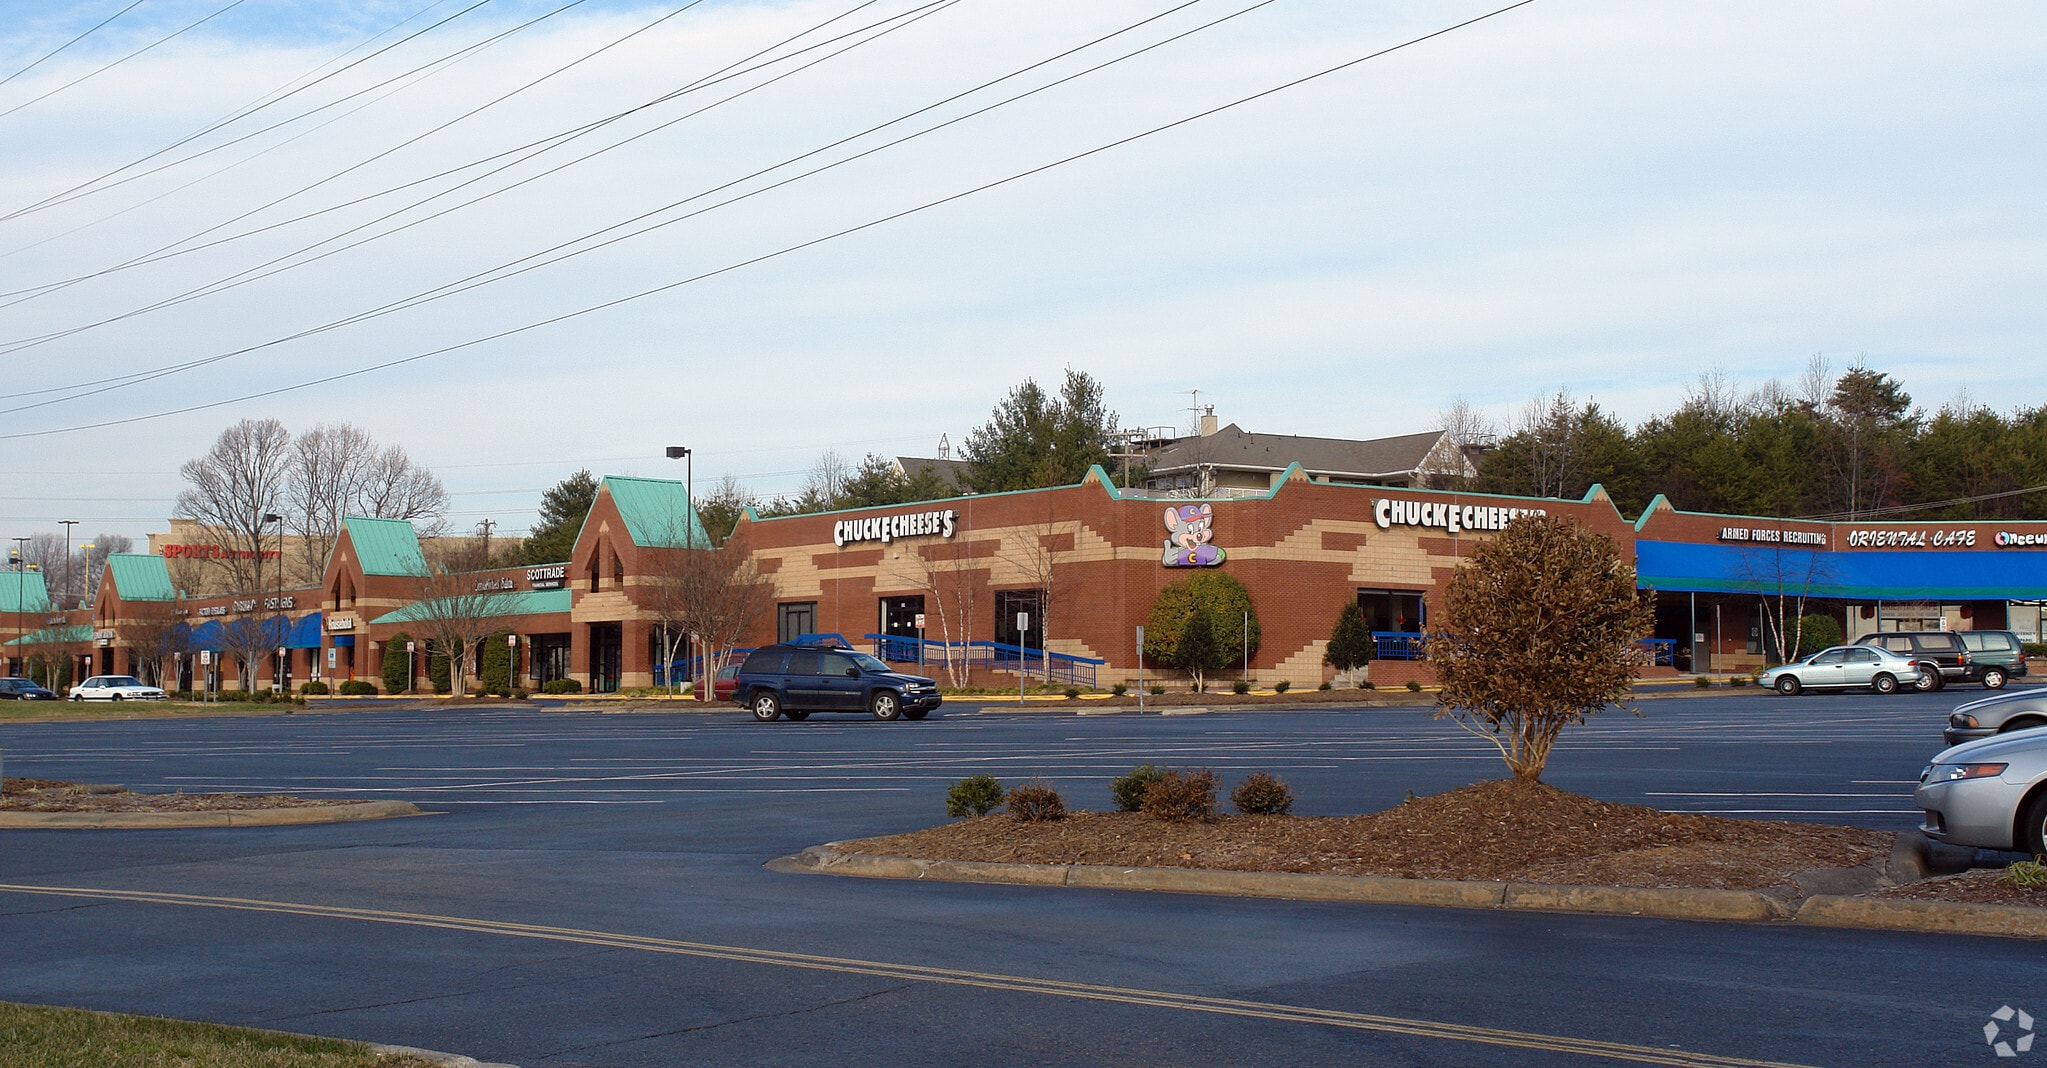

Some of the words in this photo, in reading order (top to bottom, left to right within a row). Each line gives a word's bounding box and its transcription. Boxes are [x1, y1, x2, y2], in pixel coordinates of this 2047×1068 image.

[1721, 527, 1749, 541] ARMED
[1752, 529, 1780, 542] FORCES
[1783, 531, 1827, 545] RECRUITING
[1847, 530, 1926, 546] ORIENTAL
[1931, 530, 1976, 546] CAFE
[164, 544, 220, 559] SPORTS
[526, 567, 565, 580] SCOTTRADE
